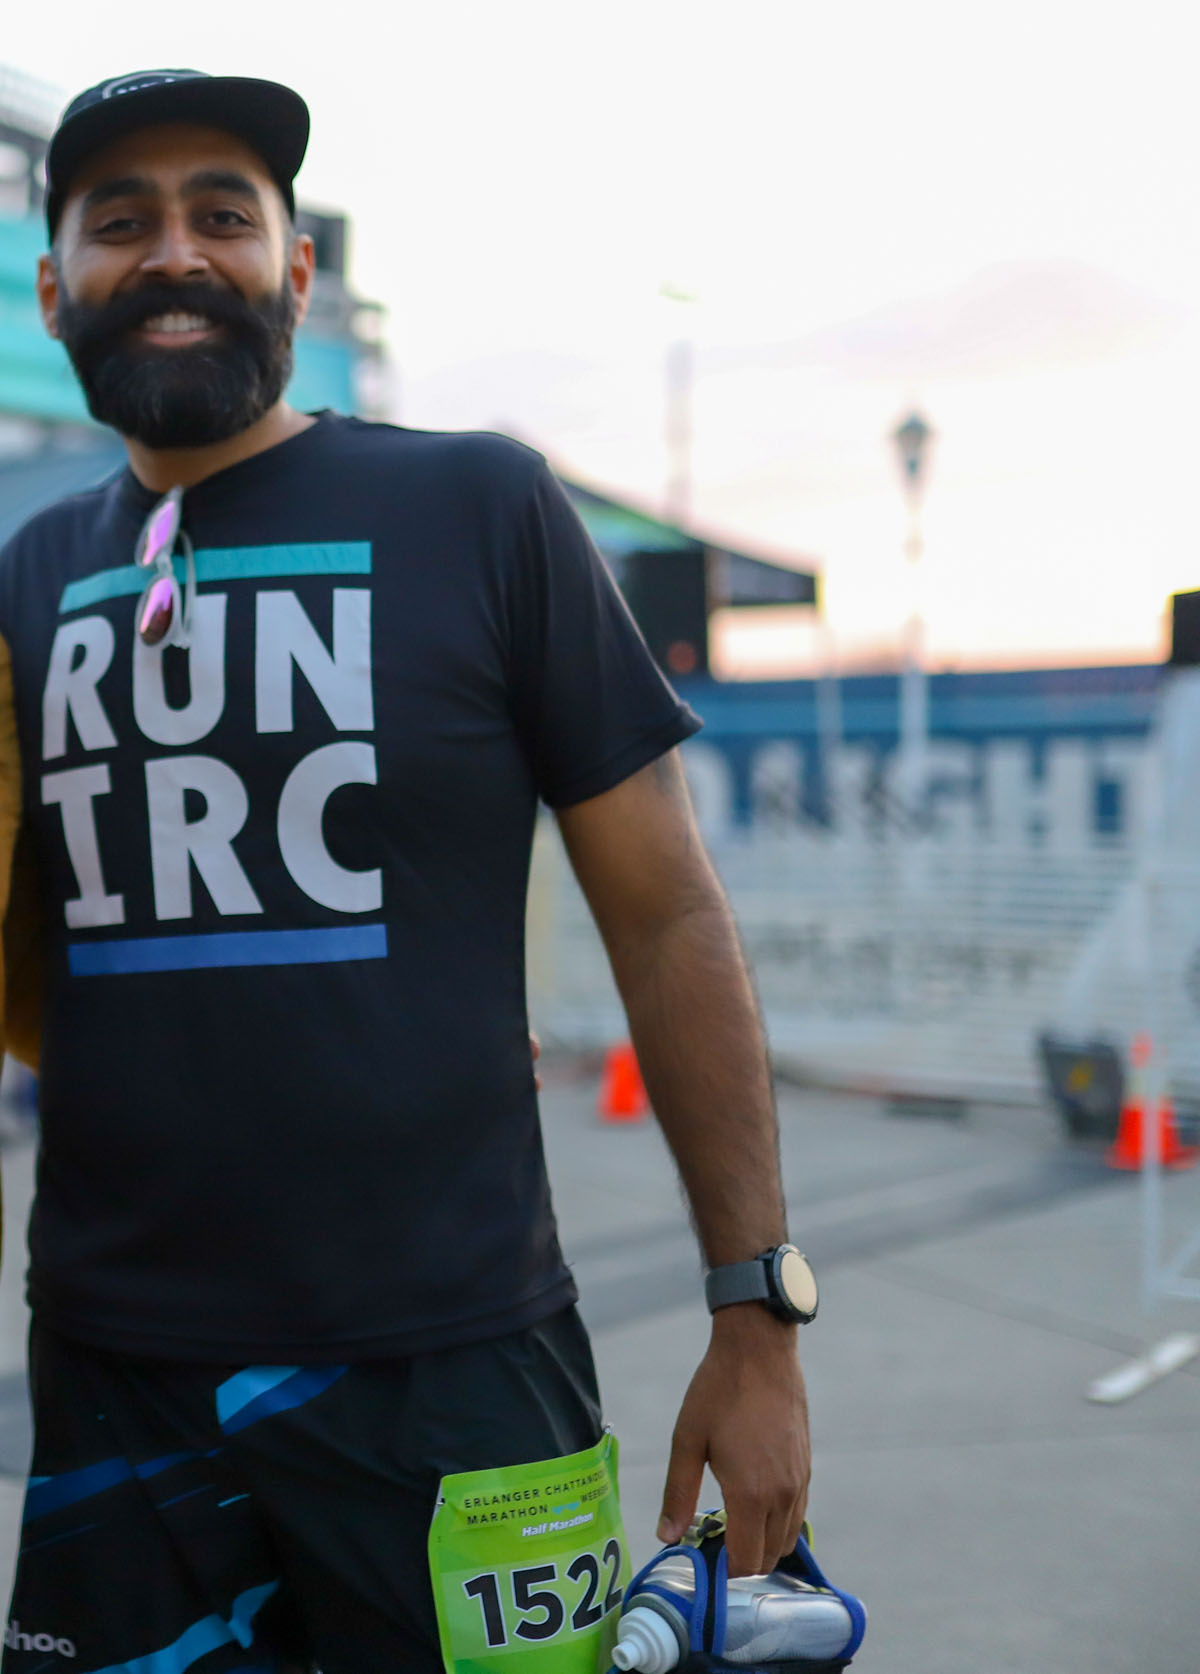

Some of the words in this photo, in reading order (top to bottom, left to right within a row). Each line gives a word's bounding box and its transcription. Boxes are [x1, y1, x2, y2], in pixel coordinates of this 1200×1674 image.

[42, 588, 375, 761] RUN
[40, 741, 383, 930] IRC
[464, 1488, 540, 1510] ERLANGER
[466, 1504, 549, 1526] MARATHON
[521, 1523, 548, 1537] Half
[549, 1512, 594, 1533] Marathon
[462, 1537, 624, 1648] 1522
